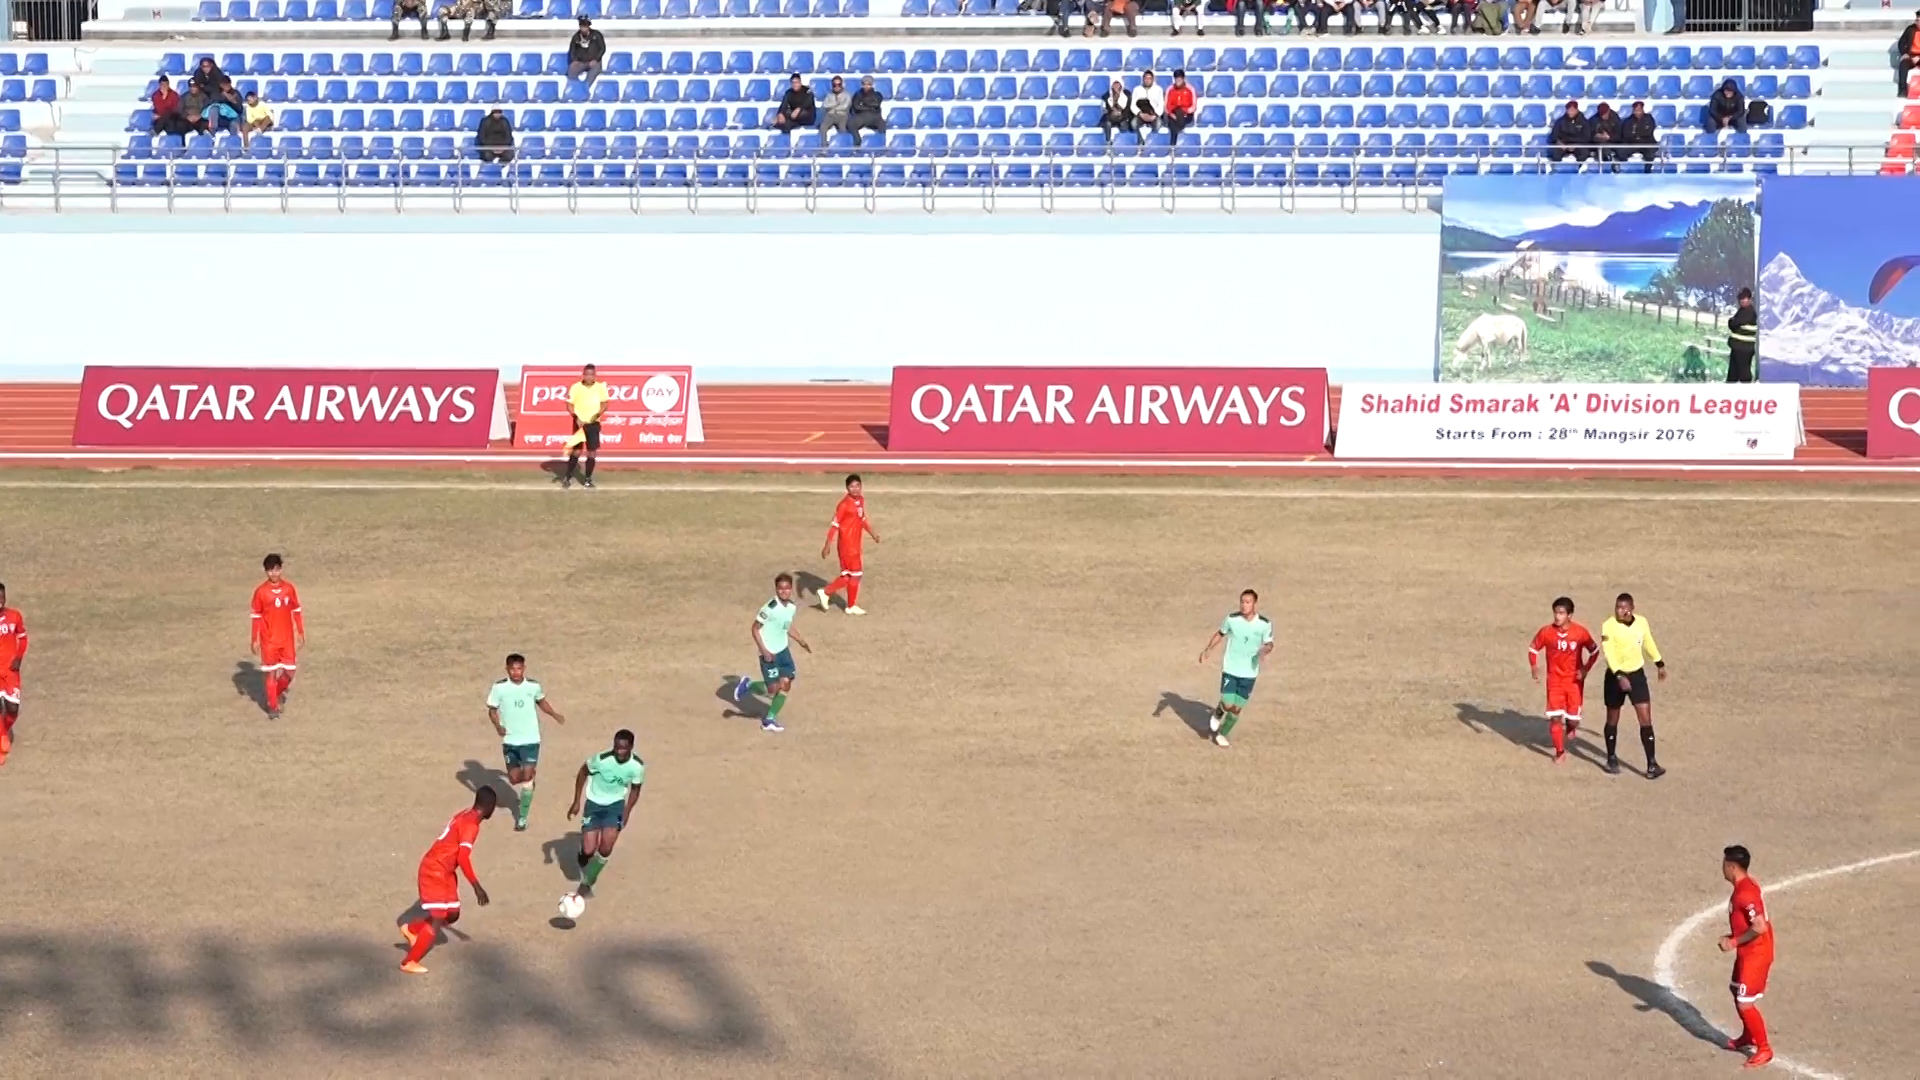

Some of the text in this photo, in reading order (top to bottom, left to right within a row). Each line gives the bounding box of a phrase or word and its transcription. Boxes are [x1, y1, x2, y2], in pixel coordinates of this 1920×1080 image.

[646, 387, 674, 397] PAY
[98, 383, 476, 429] QATAR AIRWAYS
[910, 383, 1307, 432] QATAR AIRWAYS
[1360, 393, 1441, 414] Shahid
[1449, 393, 1540, 414] Smarak
[1586, 392, 1681, 414] Division
[1689, 393, 1779, 420] League
[1435, 427, 1485, 440] Starts
[1491, 427, 1533, 440] From
[1583, 427, 1650, 443] Mangsir
[1655, 428, 1696, 441] 2076
[514, 699, 525, 709] 10
